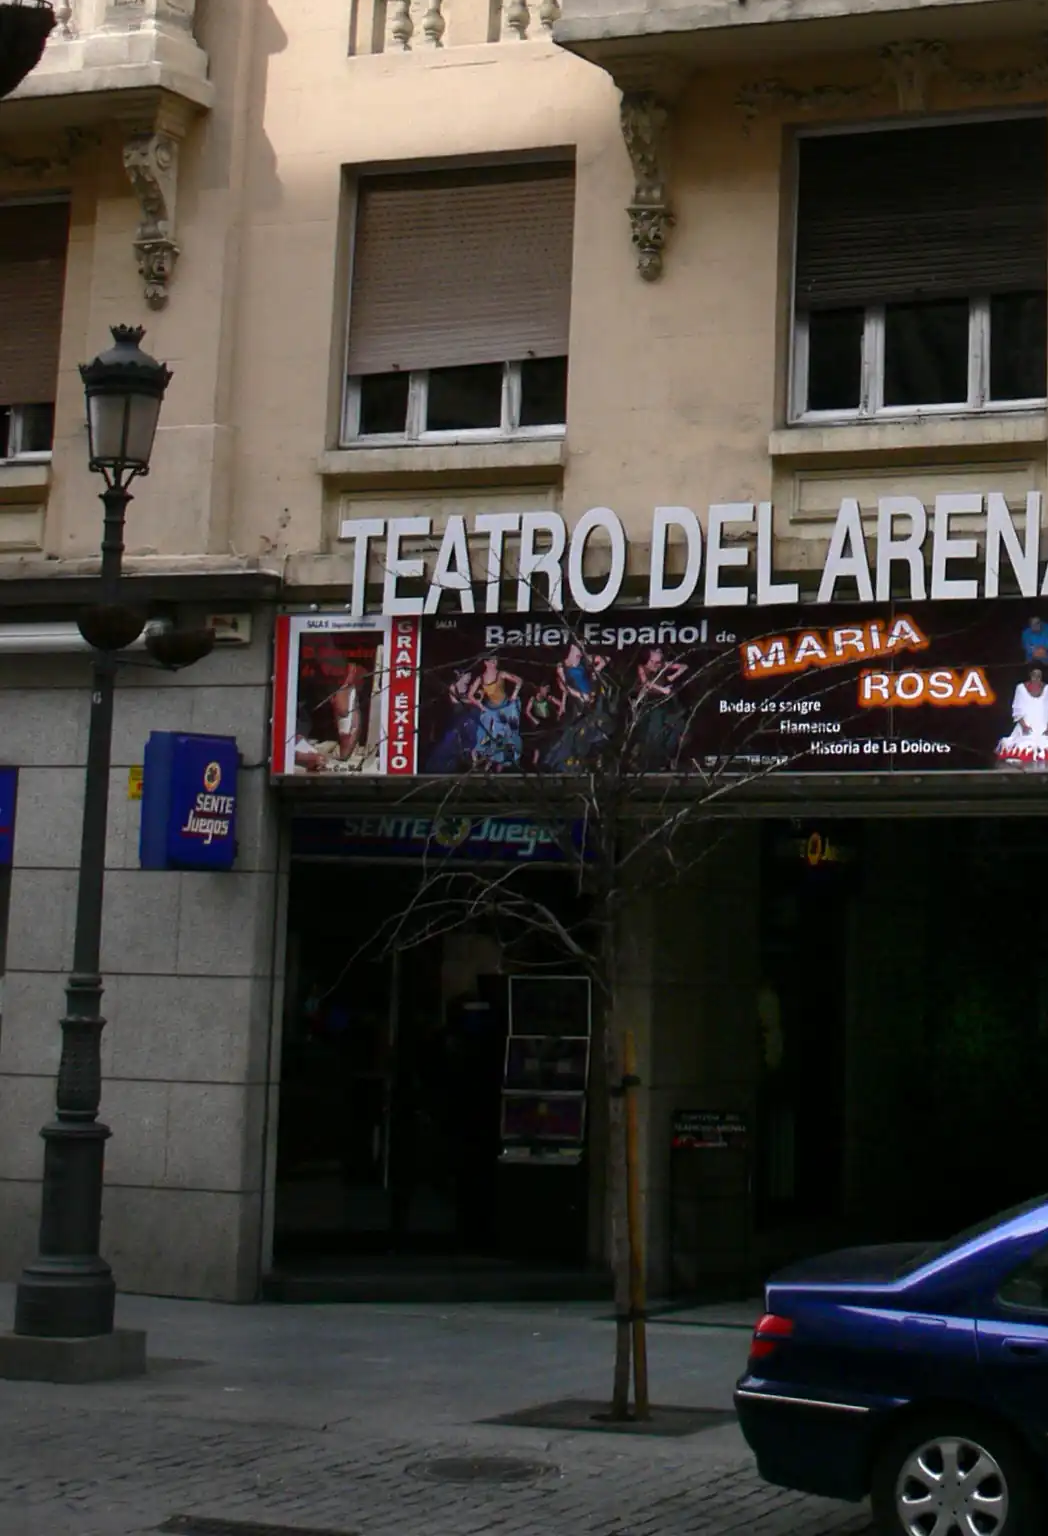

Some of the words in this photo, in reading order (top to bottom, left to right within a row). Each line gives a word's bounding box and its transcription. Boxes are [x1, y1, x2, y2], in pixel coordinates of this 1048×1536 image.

[340, 506, 627, 617] TEATRO
[649, 500, 799, 609] DEL
[396, 621, 413, 678] GRAN
[584, 619, 708, 650] Español
[715, 630, 736, 644] de
[864, 670, 987, 700] ROSA
[391, 692, 409, 769] ÉXITO
[780, 720, 841, 734] Flamenco
[810, 739, 860, 755] Historia
[863, 739, 880, 754] de
[883, 740, 897, 754] La
[901, 738, 951, 753] Dolores
[195, 793, 235, 814] SENTE
[182, 809, 230, 844] Juegos
[343, 816, 431, 838] SENTE
